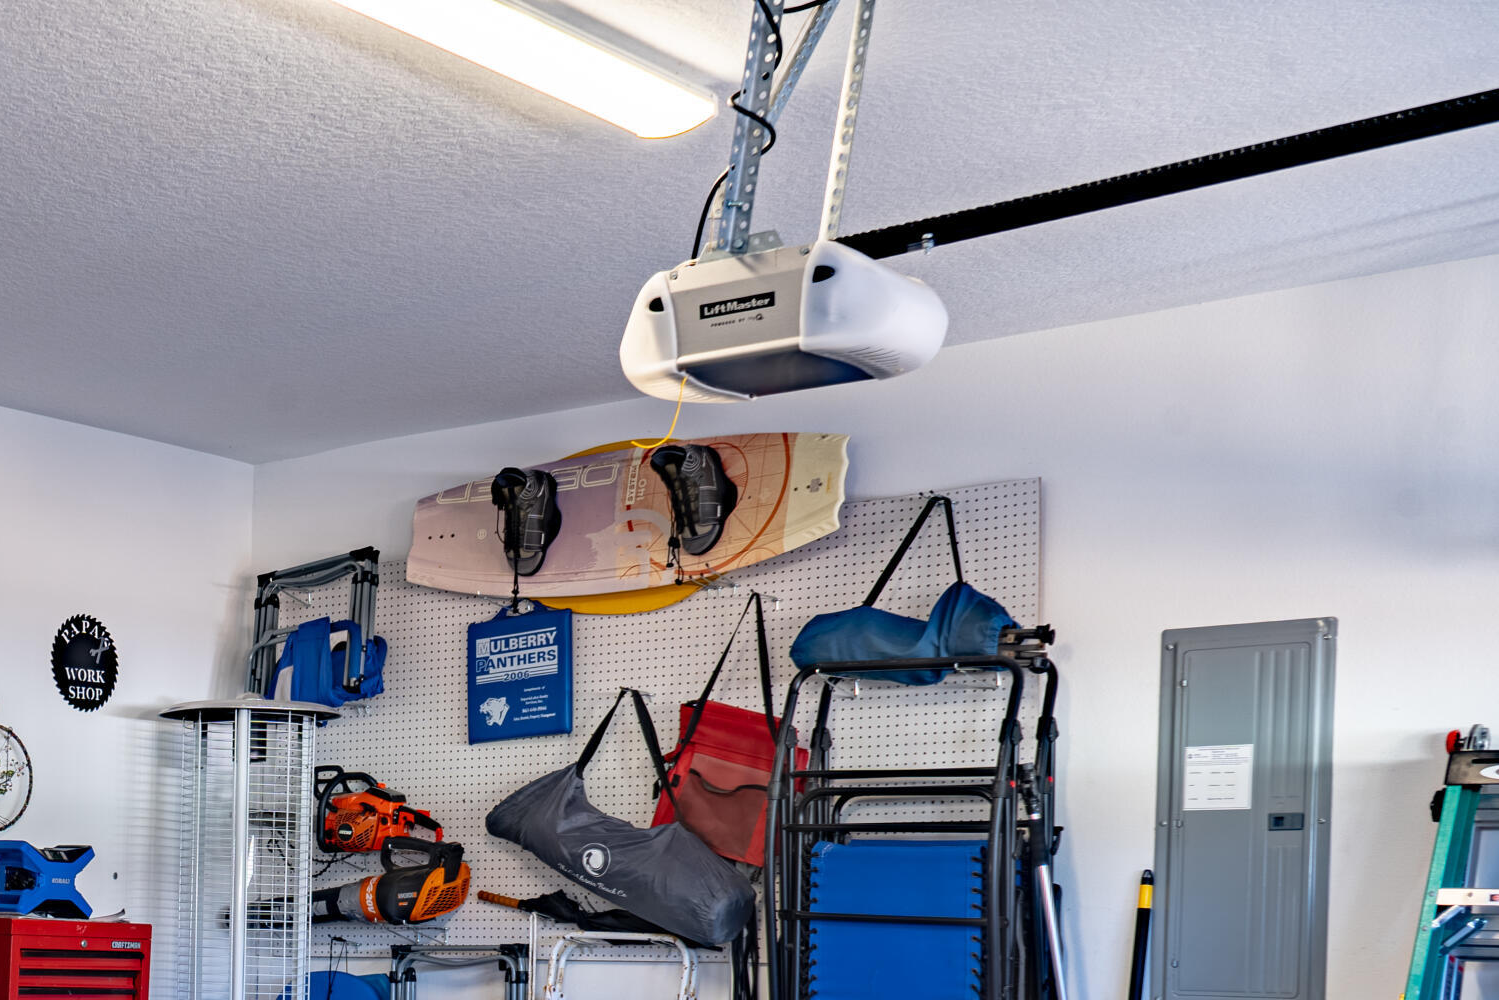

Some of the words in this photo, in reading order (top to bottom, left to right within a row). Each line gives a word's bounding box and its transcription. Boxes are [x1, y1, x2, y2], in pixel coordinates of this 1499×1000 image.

[703, 298, 771, 316] LiftMaster
[476, 630, 557, 656] MULBERRY
[476, 649, 557, 673] PANTHERS
[65, 667, 106, 684] WORK
[504, 671, 530, 682] 2006
[68, 685, 103, 701] SHOP
[111, 940, 142, 950] CRAFTSMAN
